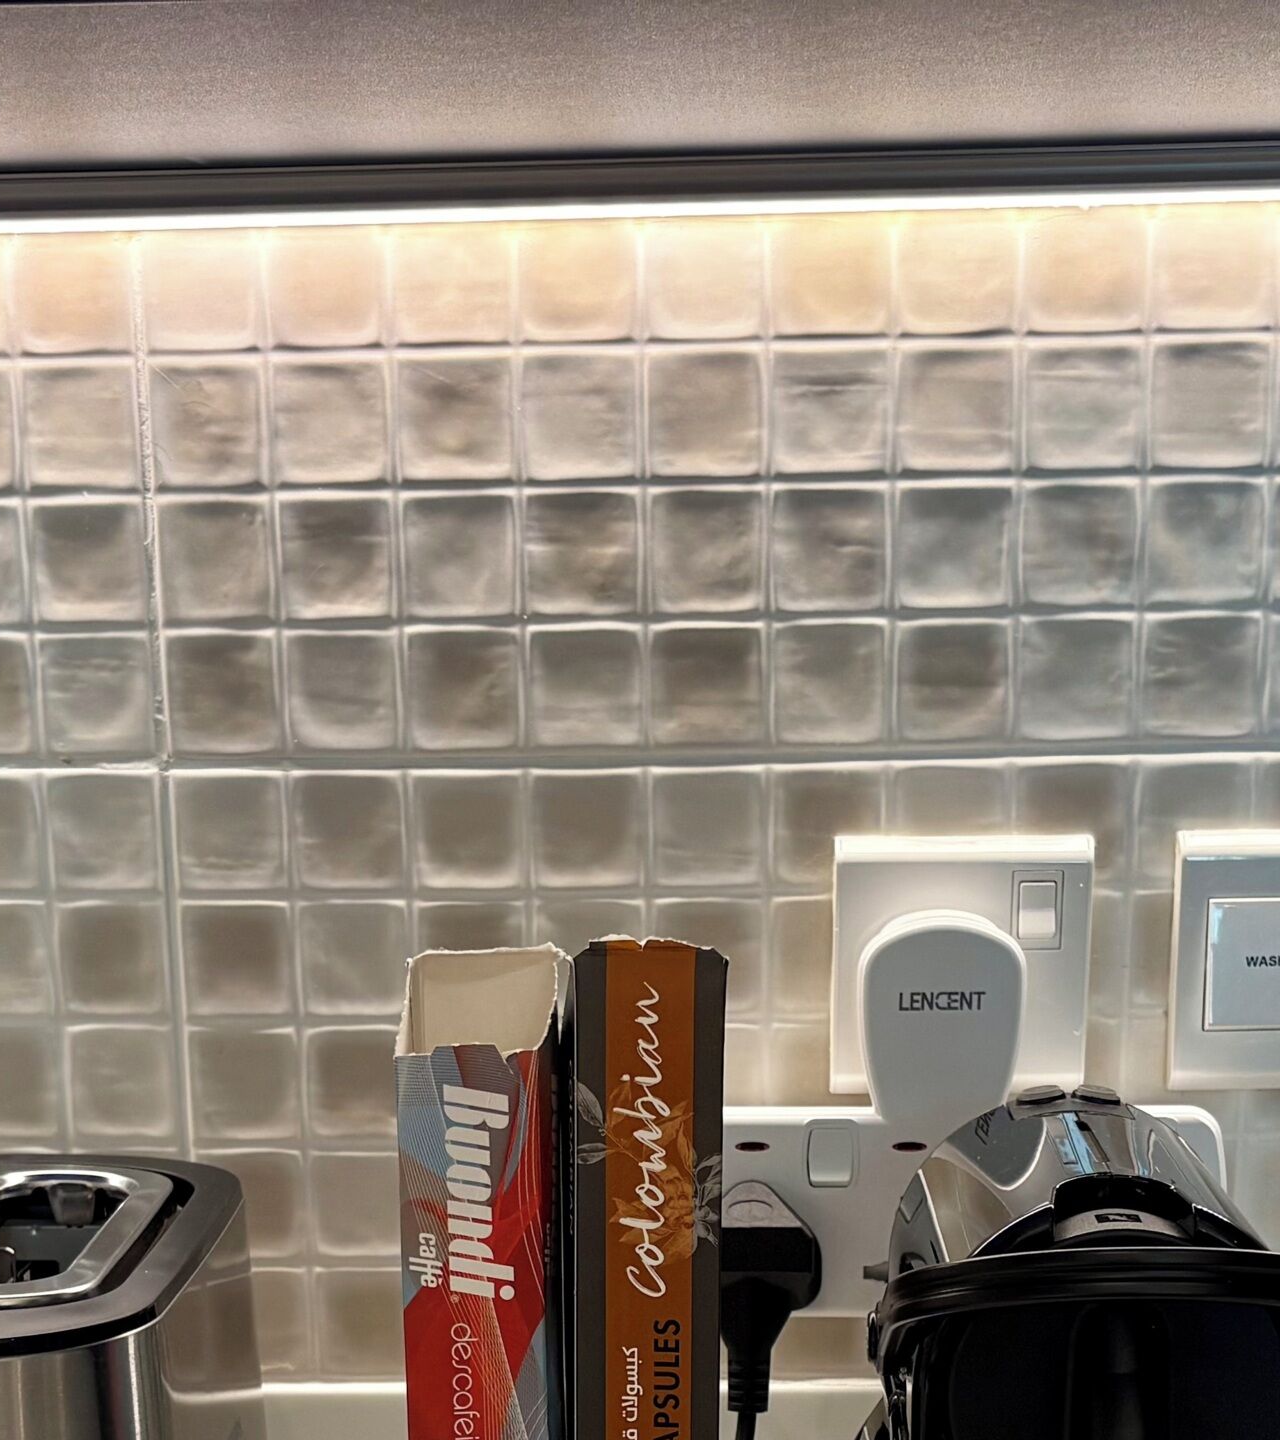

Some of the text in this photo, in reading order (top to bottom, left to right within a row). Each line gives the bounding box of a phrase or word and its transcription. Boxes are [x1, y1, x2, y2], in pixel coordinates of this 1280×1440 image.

[898, 991, 987, 1013] LENCENT
[613, 981, 671, 1299] Colombian
[621, 1345, 644, 1423] كبسولات
